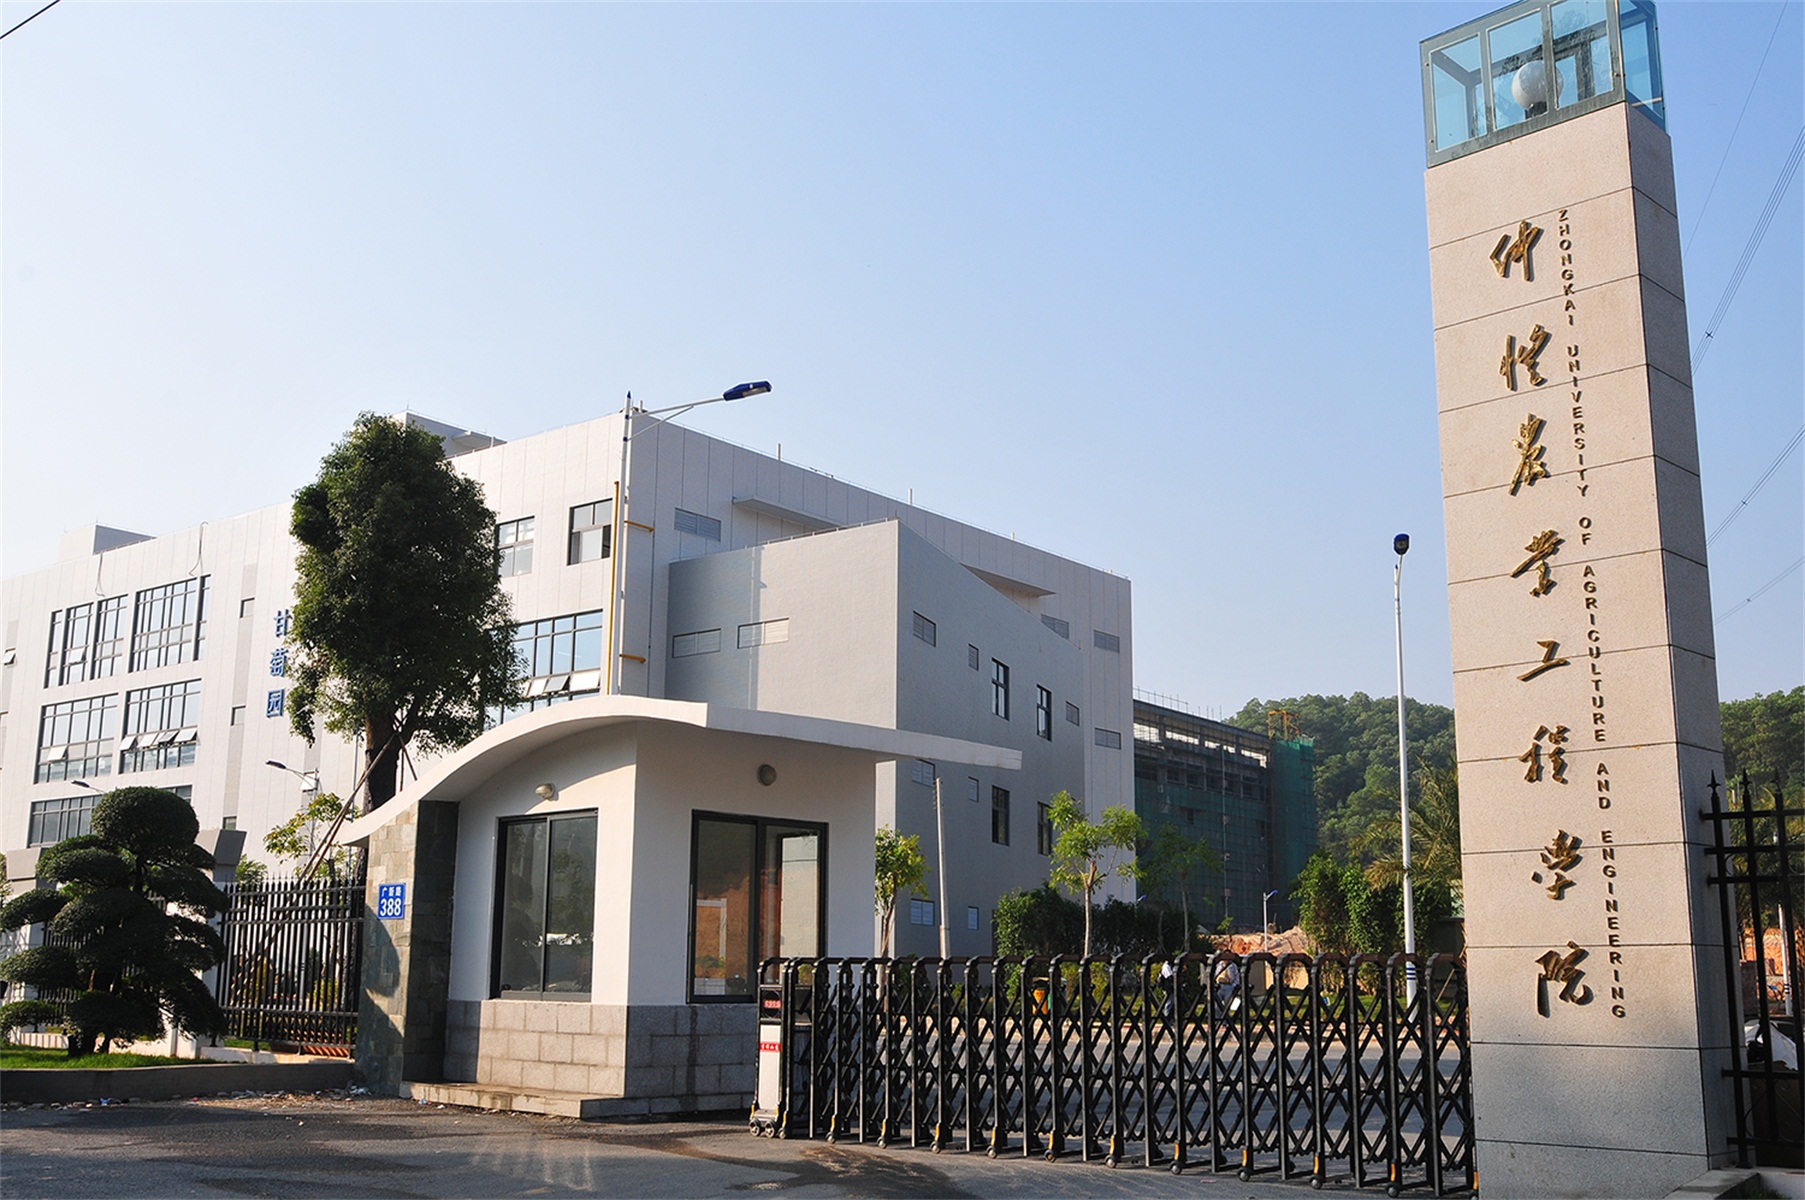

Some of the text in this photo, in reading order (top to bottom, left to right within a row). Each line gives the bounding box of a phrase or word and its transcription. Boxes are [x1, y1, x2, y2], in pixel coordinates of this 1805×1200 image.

[1557, 208, 1625, 1018] ZHONGKAI UNIVERSITY OF AGRICULTURE AND ENGINEERING
[380, 898, 402, 917] 388
